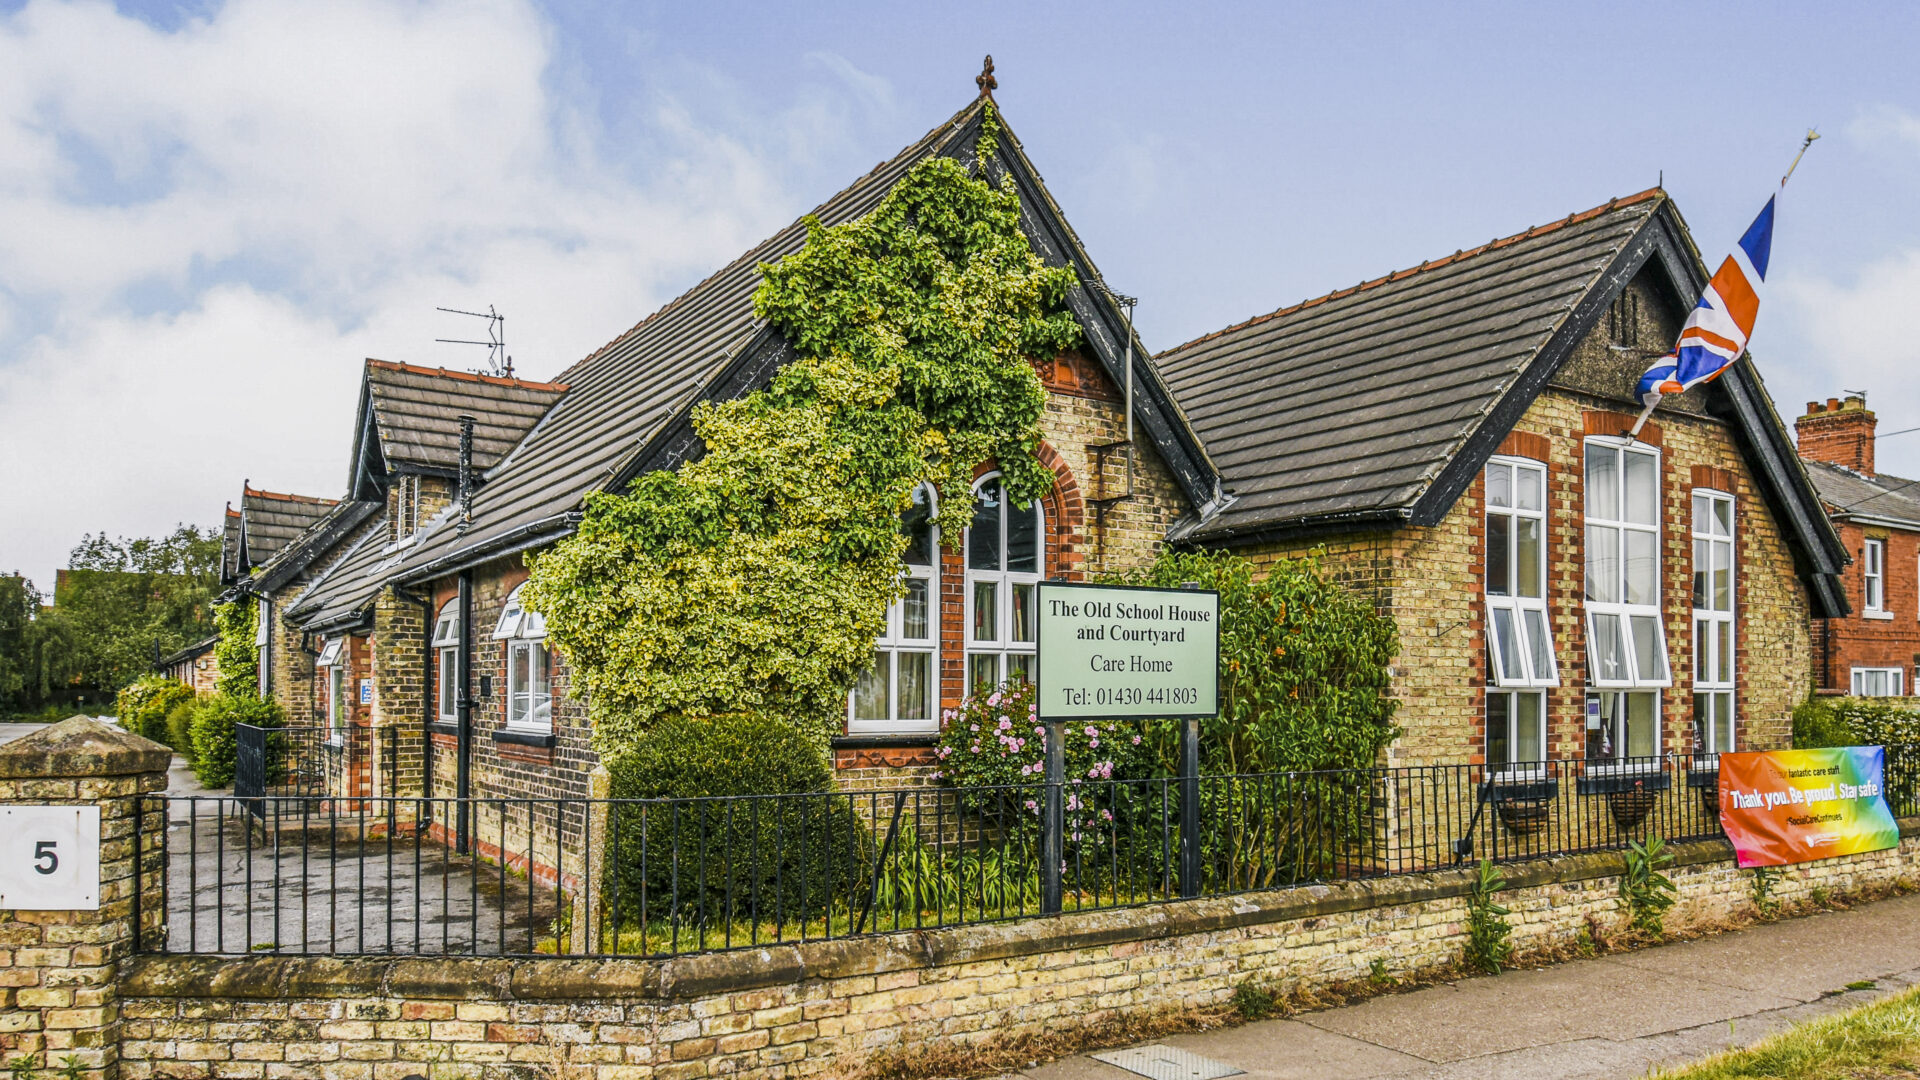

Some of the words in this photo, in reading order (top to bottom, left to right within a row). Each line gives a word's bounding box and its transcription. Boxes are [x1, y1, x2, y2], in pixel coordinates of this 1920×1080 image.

[1049, 600, 1078, 617] The
[1084, 601, 1111, 618] Old
[1116, 603, 1163, 621] School
[1169, 605, 1210, 622] House
[1077, 625, 1104, 640] and
[1110, 625, 1185, 646] Courtyard
[1090, 655, 1125, 672] Care
[1130, 656, 1173, 672] Home
[1063, 688, 1091, 705] Tel:
[1096, 688, 1142, 705] 01430
[1146, 688, 1198, 704] 441803
[1788, 768, 1811, 778] fantastic
[1827, 765, 1840, 775] staff
[1731, 789, 1764, 809] Thank
[1765, 792, 1789, 811] you.
[1789, 787, 1803, 804] Be
[1804, 784, 1837, 806] proud.
[34, 841, 58, 874] 5
